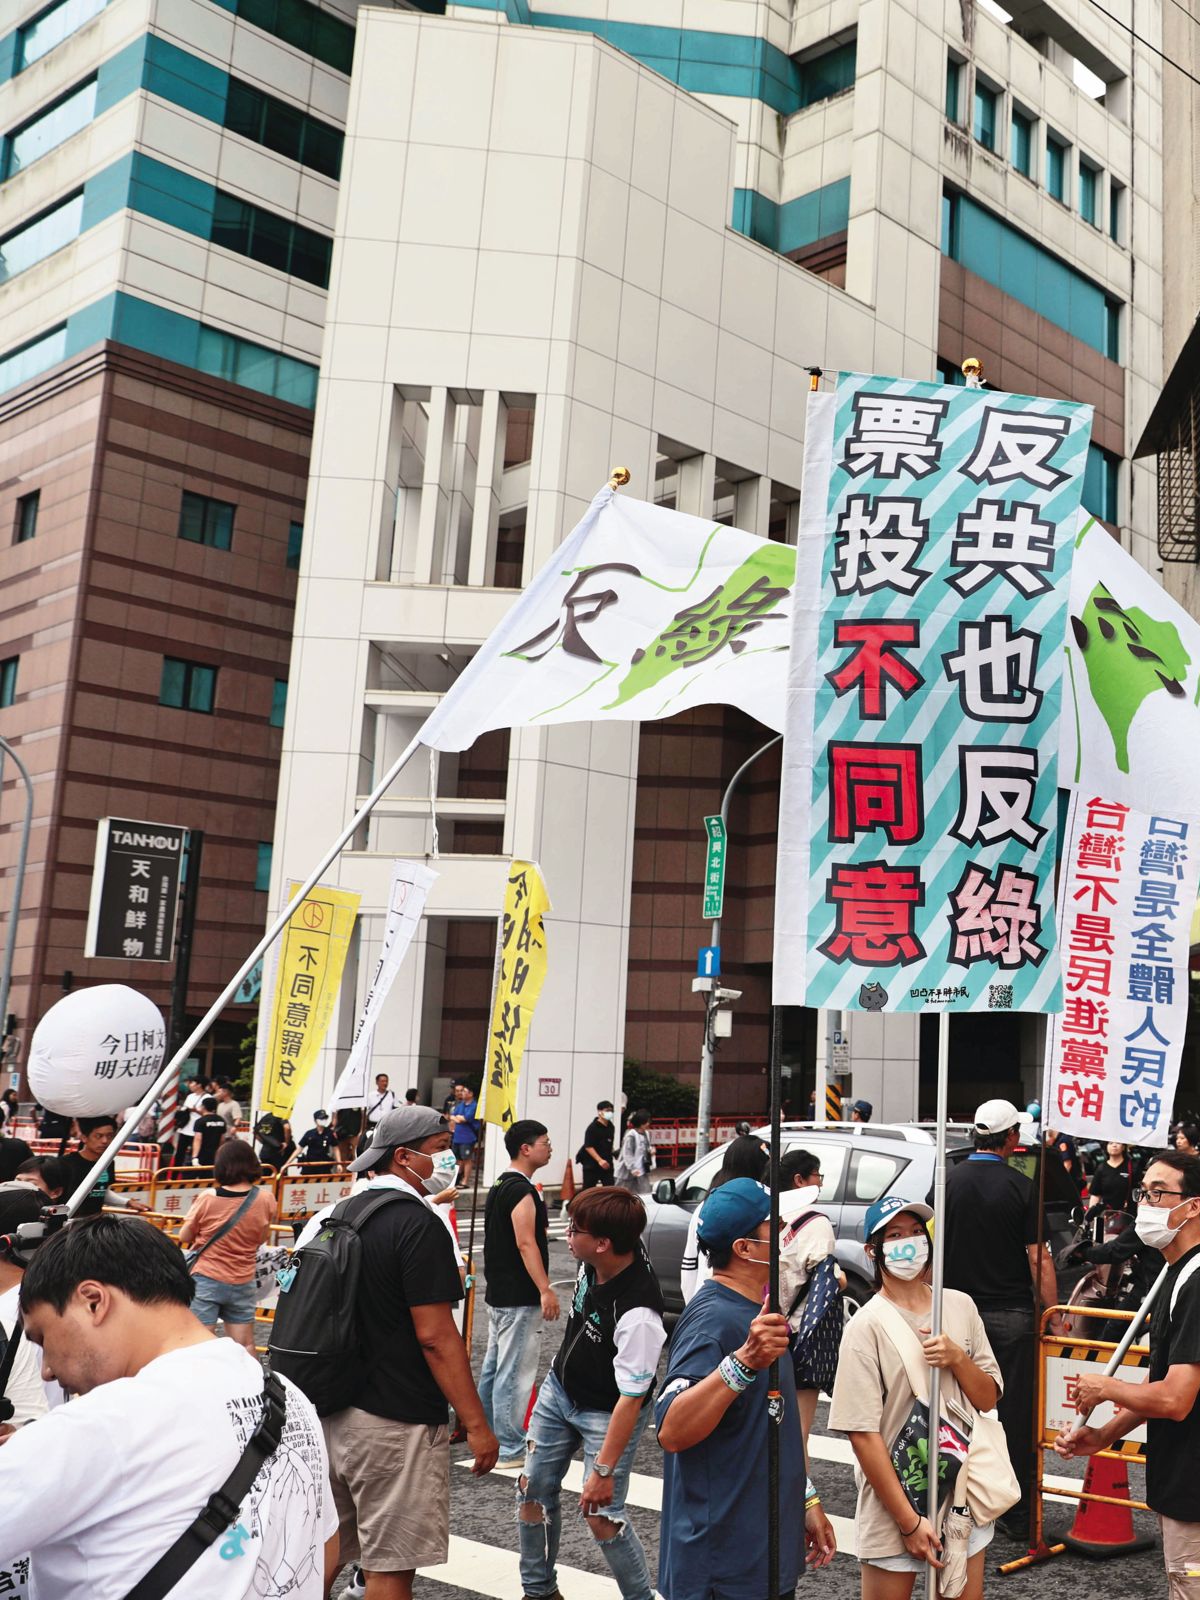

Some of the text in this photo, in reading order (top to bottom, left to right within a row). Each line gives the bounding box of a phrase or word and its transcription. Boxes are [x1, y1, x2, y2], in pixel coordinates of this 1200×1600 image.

[112, 830, 180, 851] TANHOU
[817, 391, 949, 968] 票投不同意
[944, 405, 1072, 970] 反共也反綠
[122, 859, 151, 957] 天和鮮物
